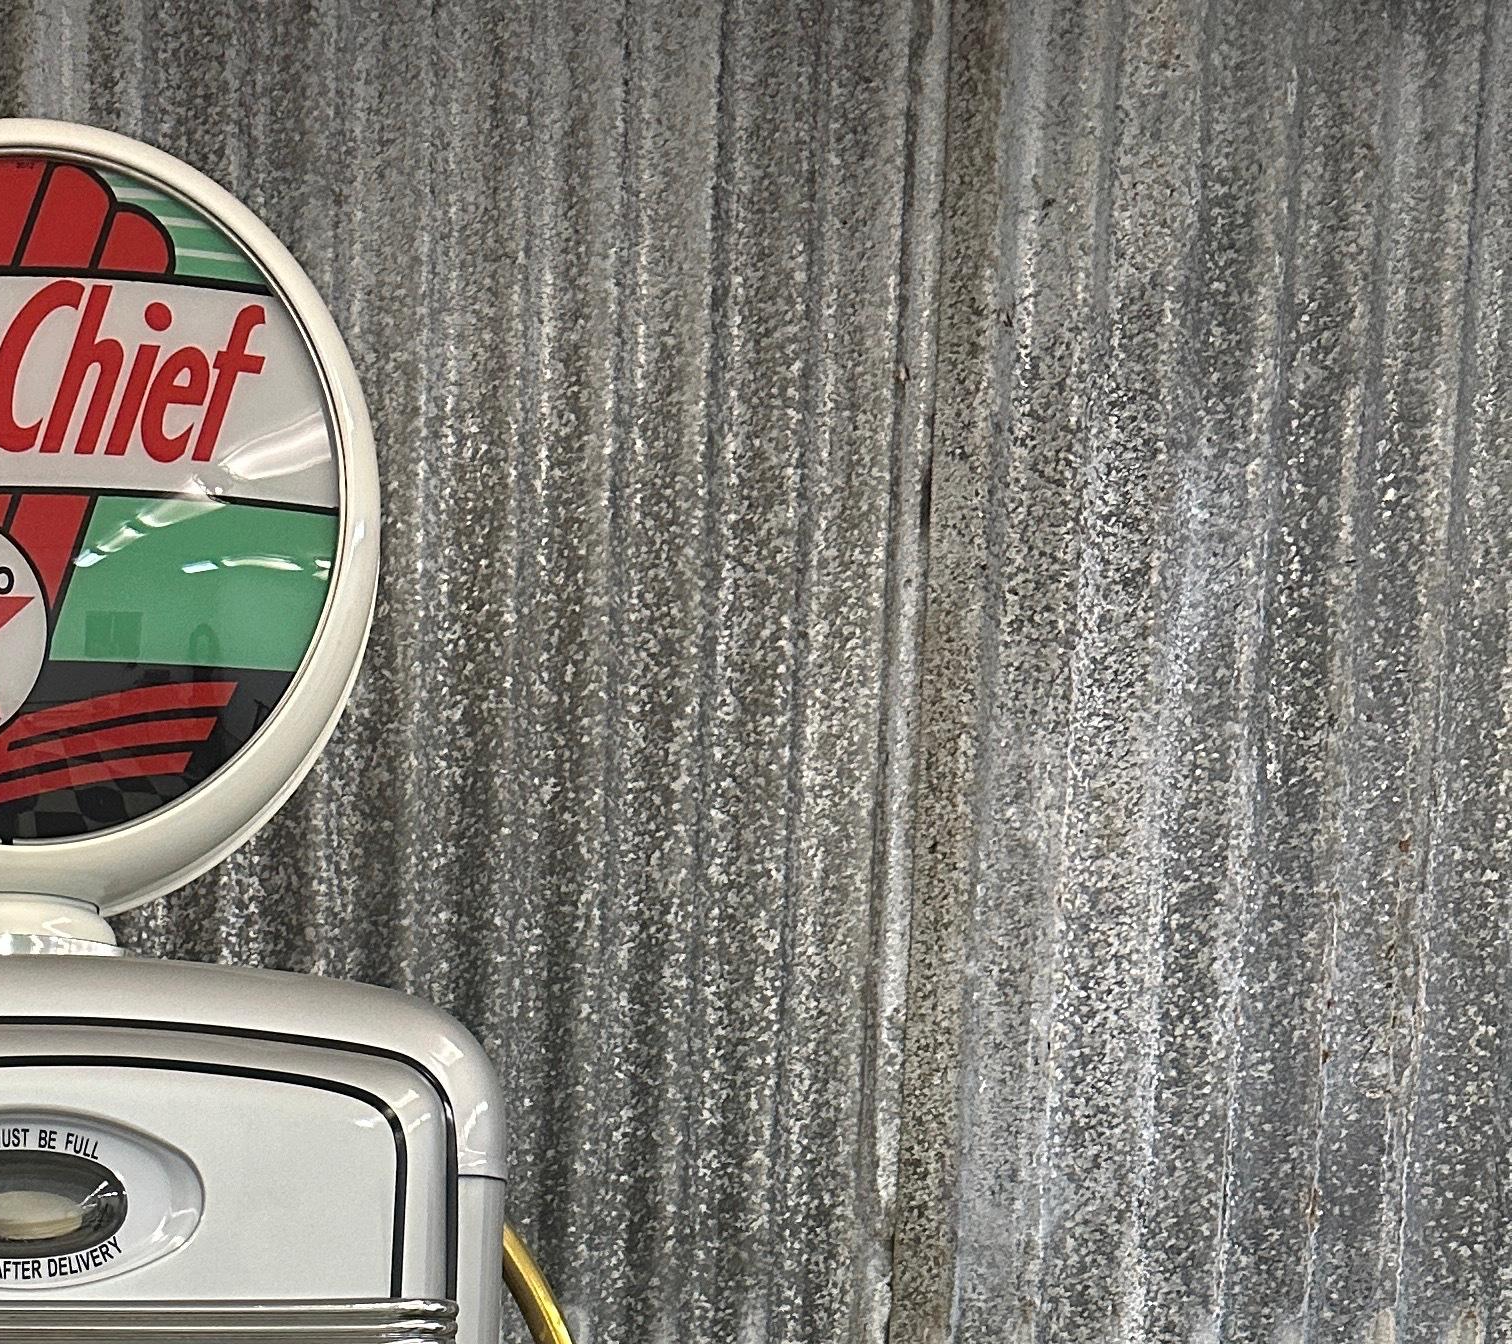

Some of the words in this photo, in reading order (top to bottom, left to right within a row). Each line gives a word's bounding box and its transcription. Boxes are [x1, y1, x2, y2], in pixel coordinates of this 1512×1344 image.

[38, 1130, 57, 1149] BE
[65, 1133, 98, 1160] FULL
[47, 1236, 123, 1278] DELIVERY
